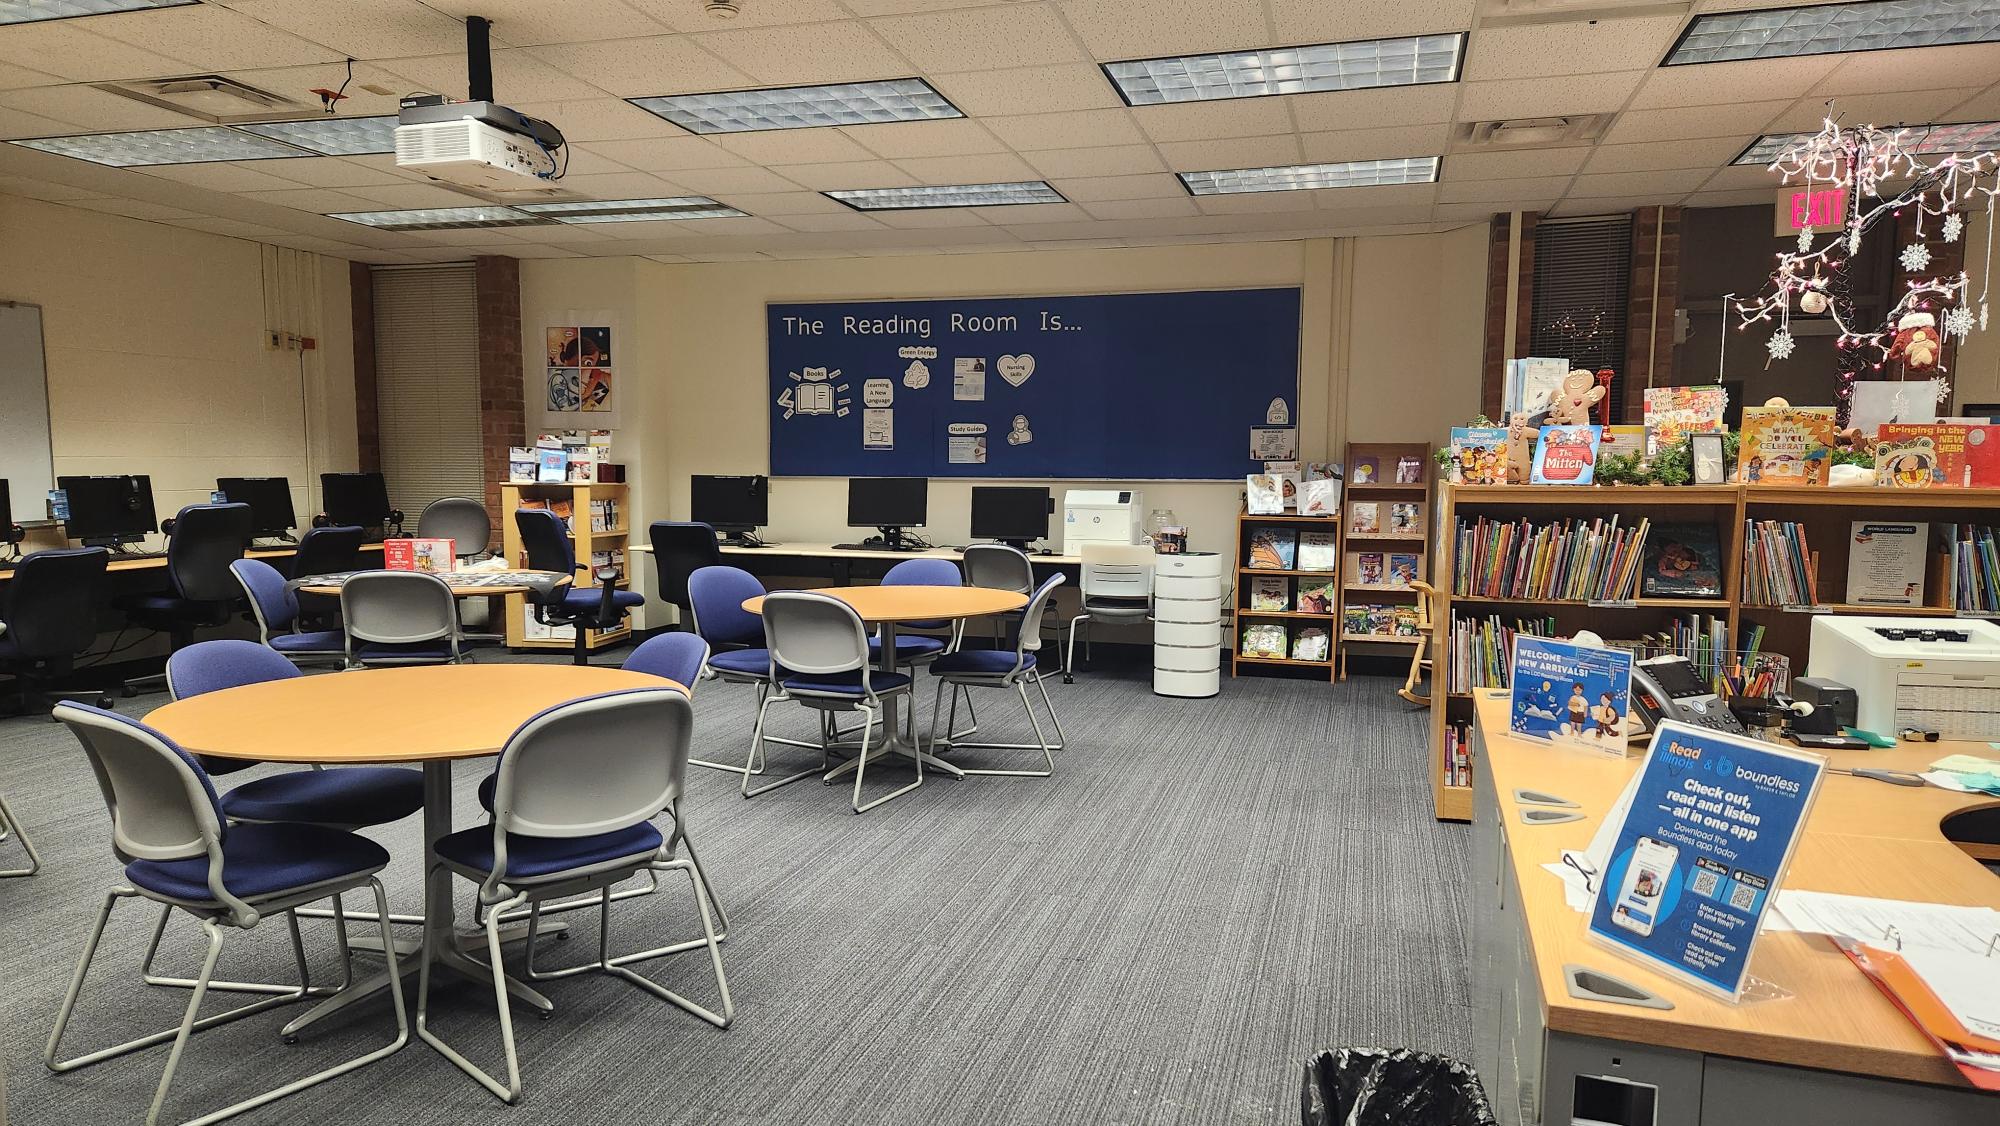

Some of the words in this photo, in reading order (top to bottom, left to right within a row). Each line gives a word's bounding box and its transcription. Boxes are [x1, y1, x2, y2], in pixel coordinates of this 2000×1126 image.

[1791, 189, 1845, 229] EXIT
[783, 317, 824, 335] The
[844, 315, 931, 338] Reading
[951, 313, 1017, 332] Room
[1040, 312, 1082, 331] Is...
[1888, 426, 1934, 436] Bringing
[1939, 435, 1966, 443] NEW
[1546, 458, 1583, 469] Mitten
[1520, 649, 1562, 663] WELCOME
[1518, 659, 1538, 668] NEW
[1540, 662, 1589, 678] ARRIVALS!
[1660, 752, 1695, 769] Illinois
[1662, 741, 1702, 760] eRead
[1704, 760, 1713, 770] &
[1736, 765, 1800, 793] boundless
[1684, 779, 1724, 799] Check
[1725, 792, 1751, 810] out,
[1666, 790, 1697, 807] read
[1697, 799, 1723, 815] and
[1724, 804, 1760, 826] listen
[1673, 806, 1690, 820] all
[1690, 810, 1702, 824] in
[1704, 816, 1729, 831] one
[1730, 824, 1757, 842] app
[1658, 826, 1695, 846] Boundless
[1696, 840, 1712, 852] app
[1714, 844, 1738, 860] today
[1674, 822, 1714, 841] Download
[1714, 834, 1728, 846] the
[1705, 863, 1719, 872] Google
[1719, 867, 1728, 875] Play
[1742, 876, 1752, 884] App
[1752, 879, 1765, 888] Store
[1700, 903, 1715, 914] Enter
[1714, 910, 1727, 919] your
[1727, 914, 1746, 927] library
[1704, 913, 1717, 922] (one
[1691, 929, 1710, 943] library
[1710, 938, 1737, 952] collection
[1693, 922, 1712, 936] Browse
[1712, 931, 1726, 940] your
[1685, 949, 1698, 958] read
[1704, 957, 1720, 967] listen
[1687, 942, 1704, 953] Check
[1714, 954, 1726, 963] and
[1683, 955, 1706, 970] instantly
